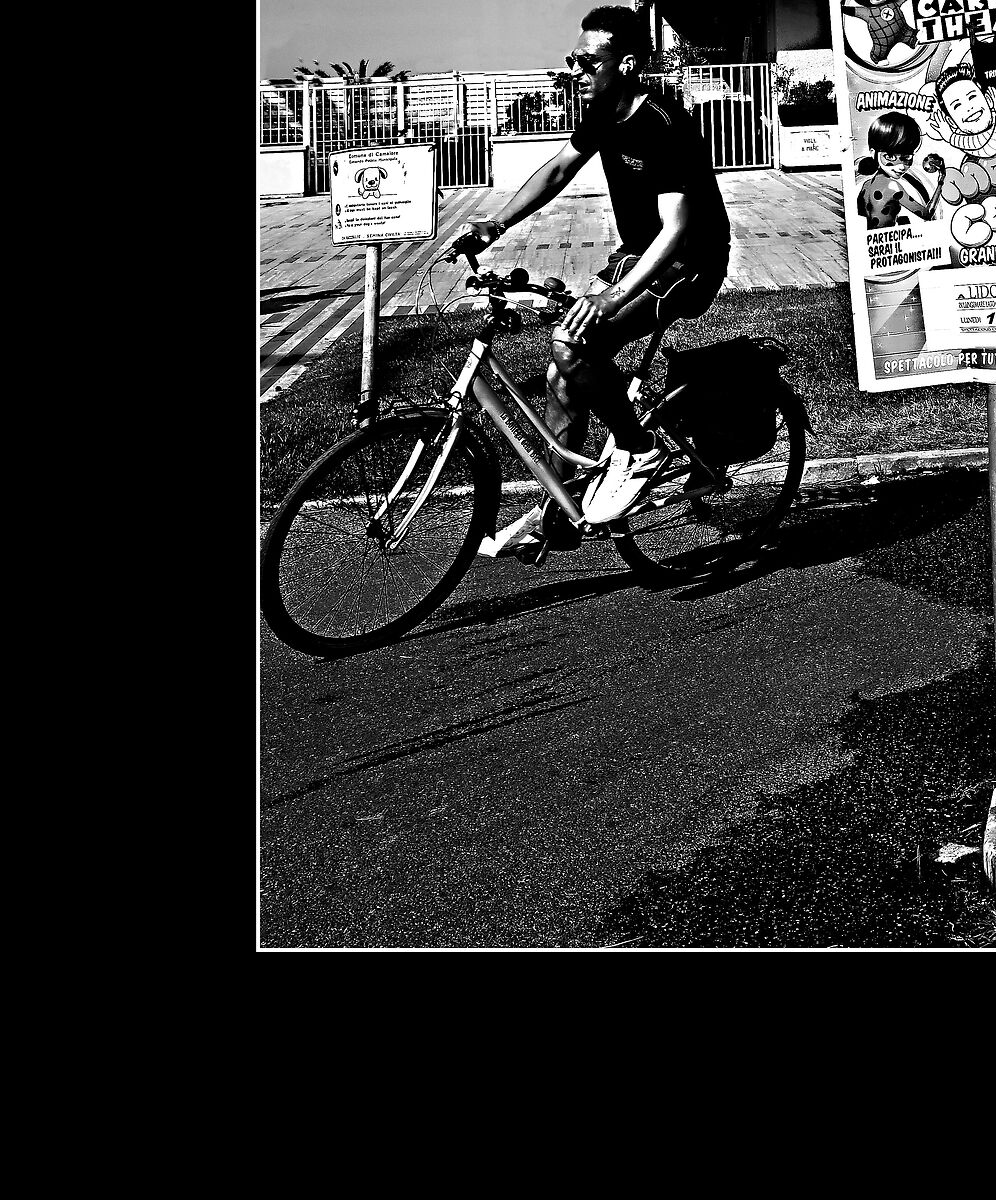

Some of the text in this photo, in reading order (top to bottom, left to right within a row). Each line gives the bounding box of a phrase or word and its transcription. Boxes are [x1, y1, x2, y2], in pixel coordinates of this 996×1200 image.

[856, 91, 934, 111] ANIMAZIONE
[868, 242, 902, 258] SARAI IL
[884, 354, 953, 374] SPETTACOLO
[959, 353, 978, 366] PER
